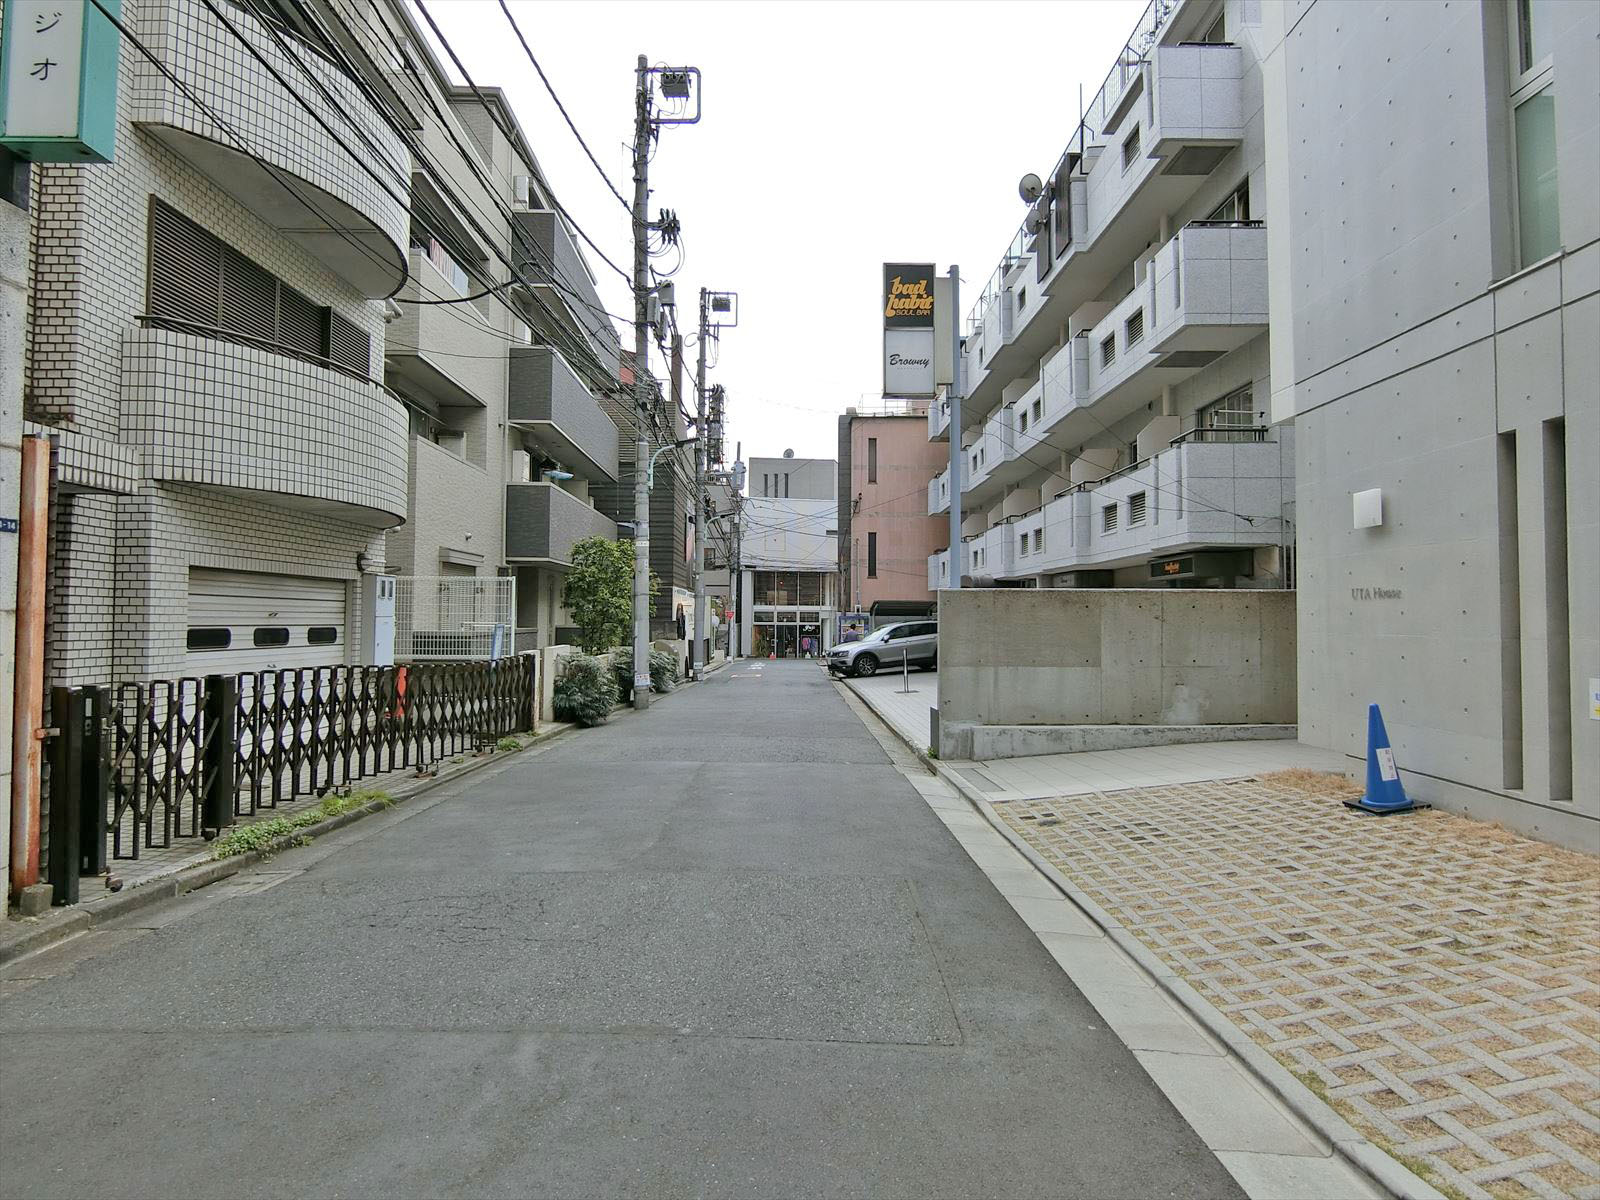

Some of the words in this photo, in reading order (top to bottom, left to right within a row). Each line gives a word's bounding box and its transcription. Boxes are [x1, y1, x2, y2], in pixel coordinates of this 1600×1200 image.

[30, 12, 62, 81] ジオ
[890, 276, 927, 295] bad
[885, 294, 934, 317] habit
[889, 353, 930, 369] Browny
